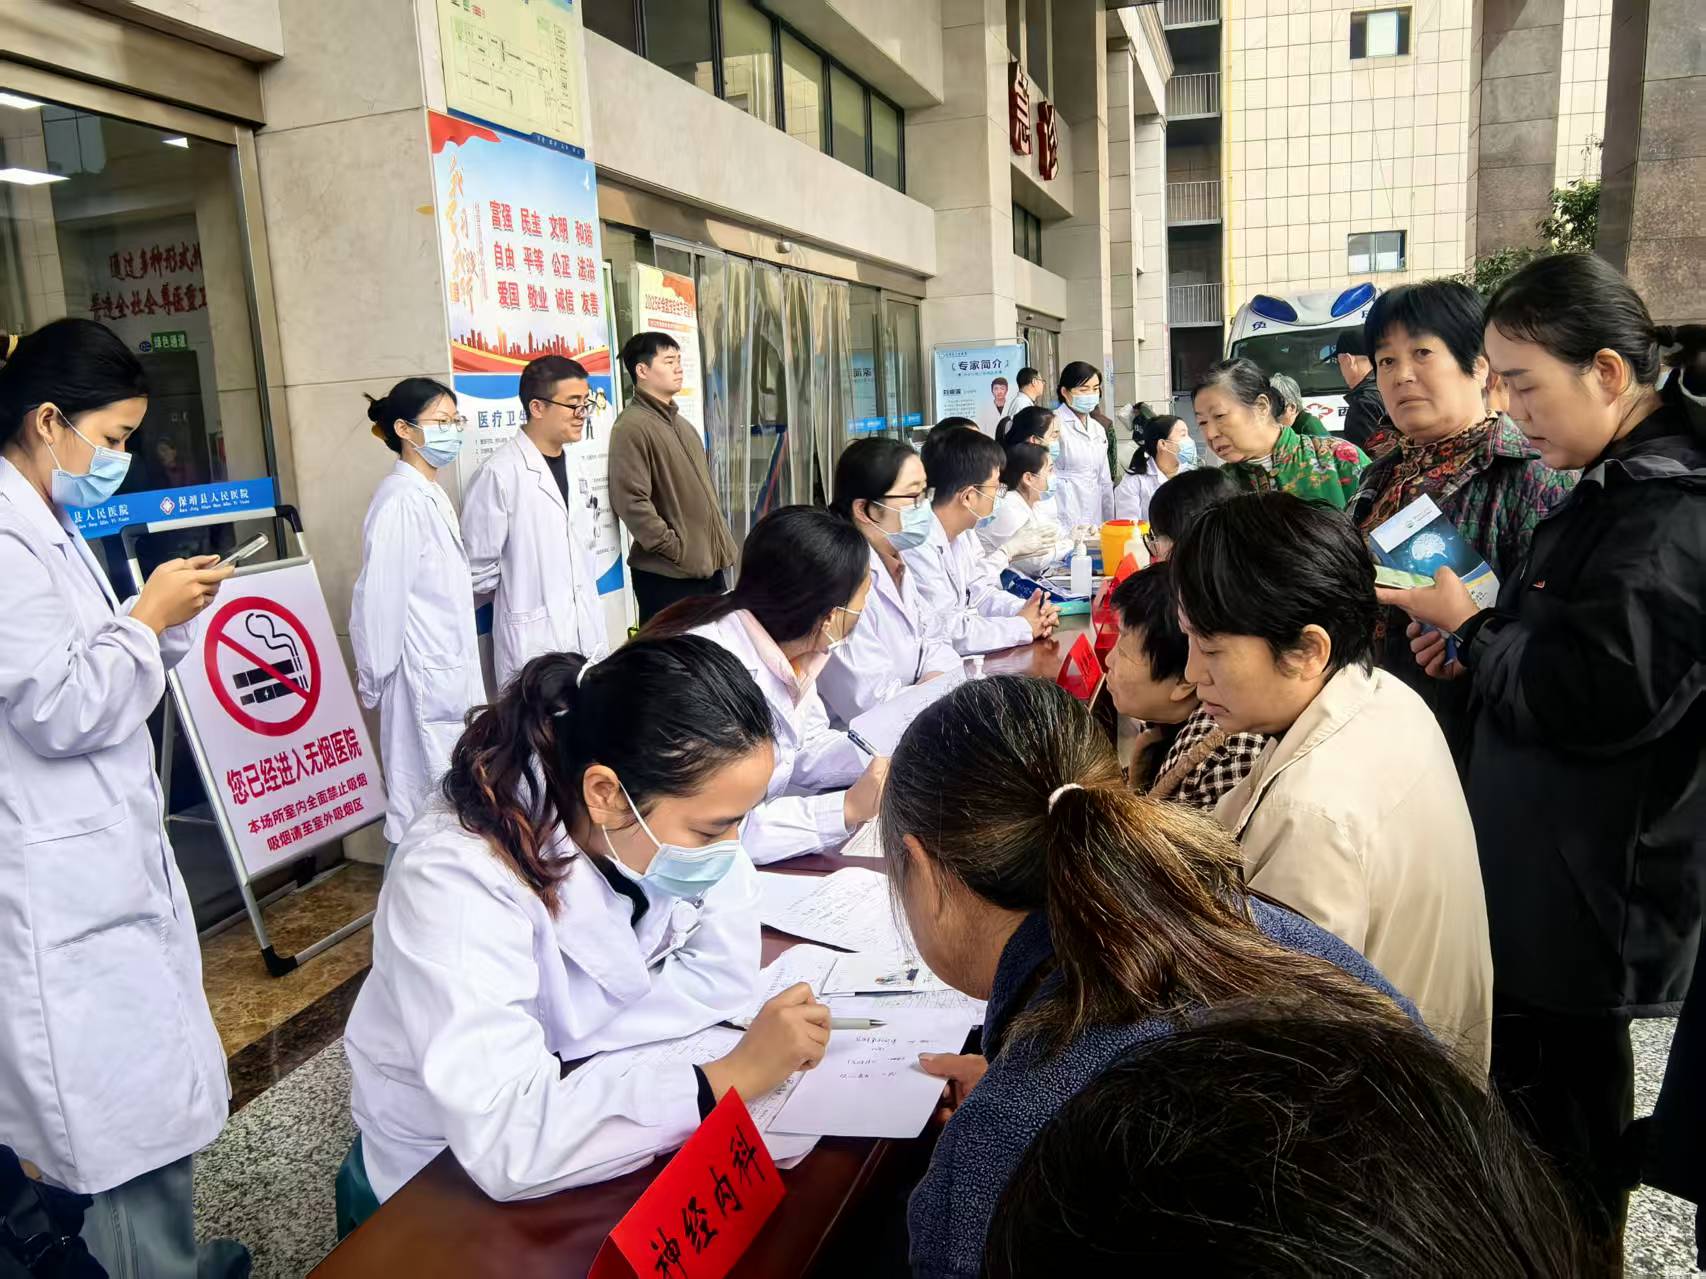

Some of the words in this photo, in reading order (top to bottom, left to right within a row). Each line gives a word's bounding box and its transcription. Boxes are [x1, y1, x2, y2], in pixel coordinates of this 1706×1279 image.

[490, 200, 513, 231] 富强
[520, 208, 542, 236] 民主
[548, 214, 568, 242] 文明
[574, 220, 593, 247] 和谐
[494, 241, 515, 270] 自由
[523, 246, 544, 274] 平等
[551, 252, 571, 278] 公正
[577, 255, 596, 282] 法治
[497, 281, 520, 309] 爱国
[527, 284, 549, 311] 敬业
[555, 288, 575, 314] 诚信
[581, 291, 599, 316] 友善
[958, 358, 1002, 371] 专家简介
[178, 488, 249, 508] 保靖县人民医院
[226, 726, 362, 805] 您已经进入无烟医院
[247, 772, 368, 834] 本场所室内全面禁止吸烟
[266, 797, 364, 851] 吸烟请至室外吸烟区
[650, 1124, 765, 1279] 神经内科
